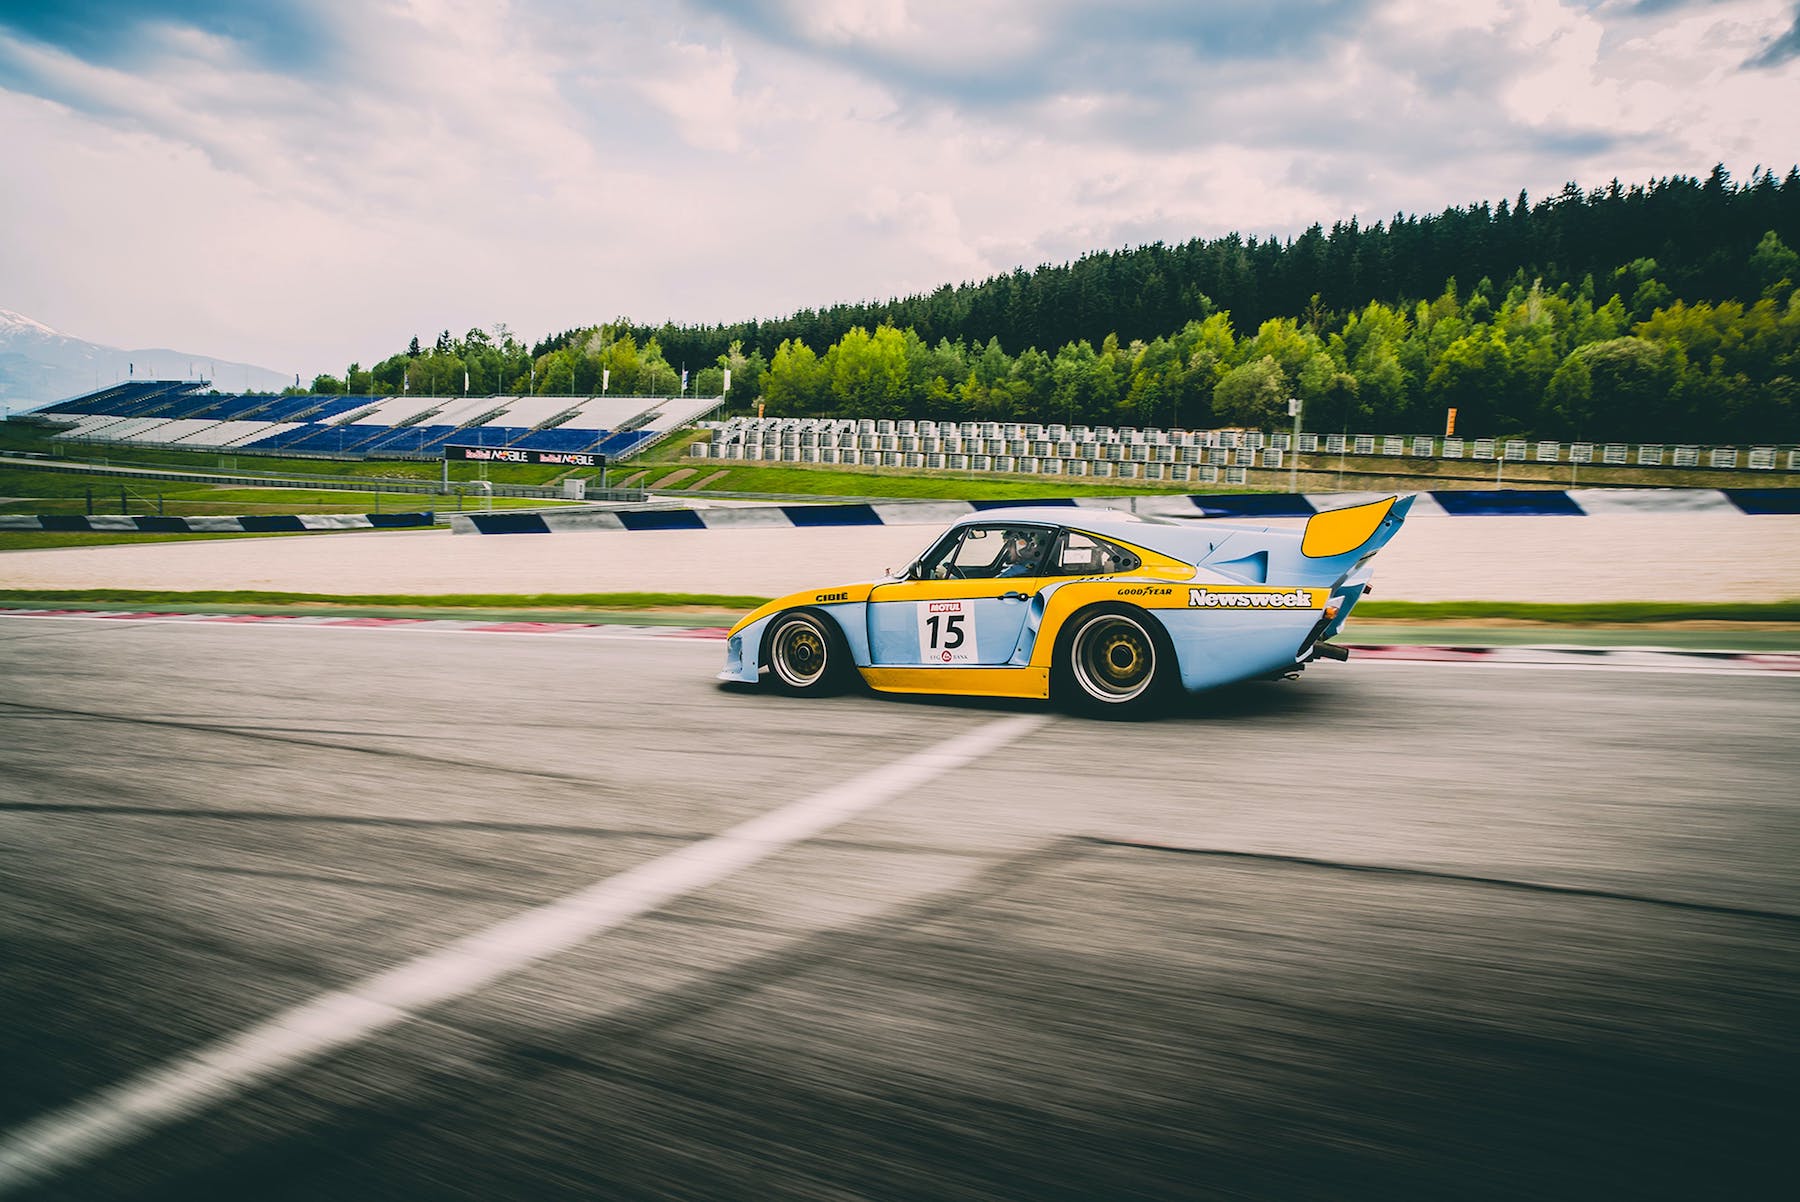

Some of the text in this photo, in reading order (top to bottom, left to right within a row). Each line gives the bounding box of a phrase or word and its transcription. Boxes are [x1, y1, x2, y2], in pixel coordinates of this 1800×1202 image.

[1188, 588, 1312, 607] Newsweek
[930, 603, 961, 612] MOTUL
[926, 615, 965, 649] 15
